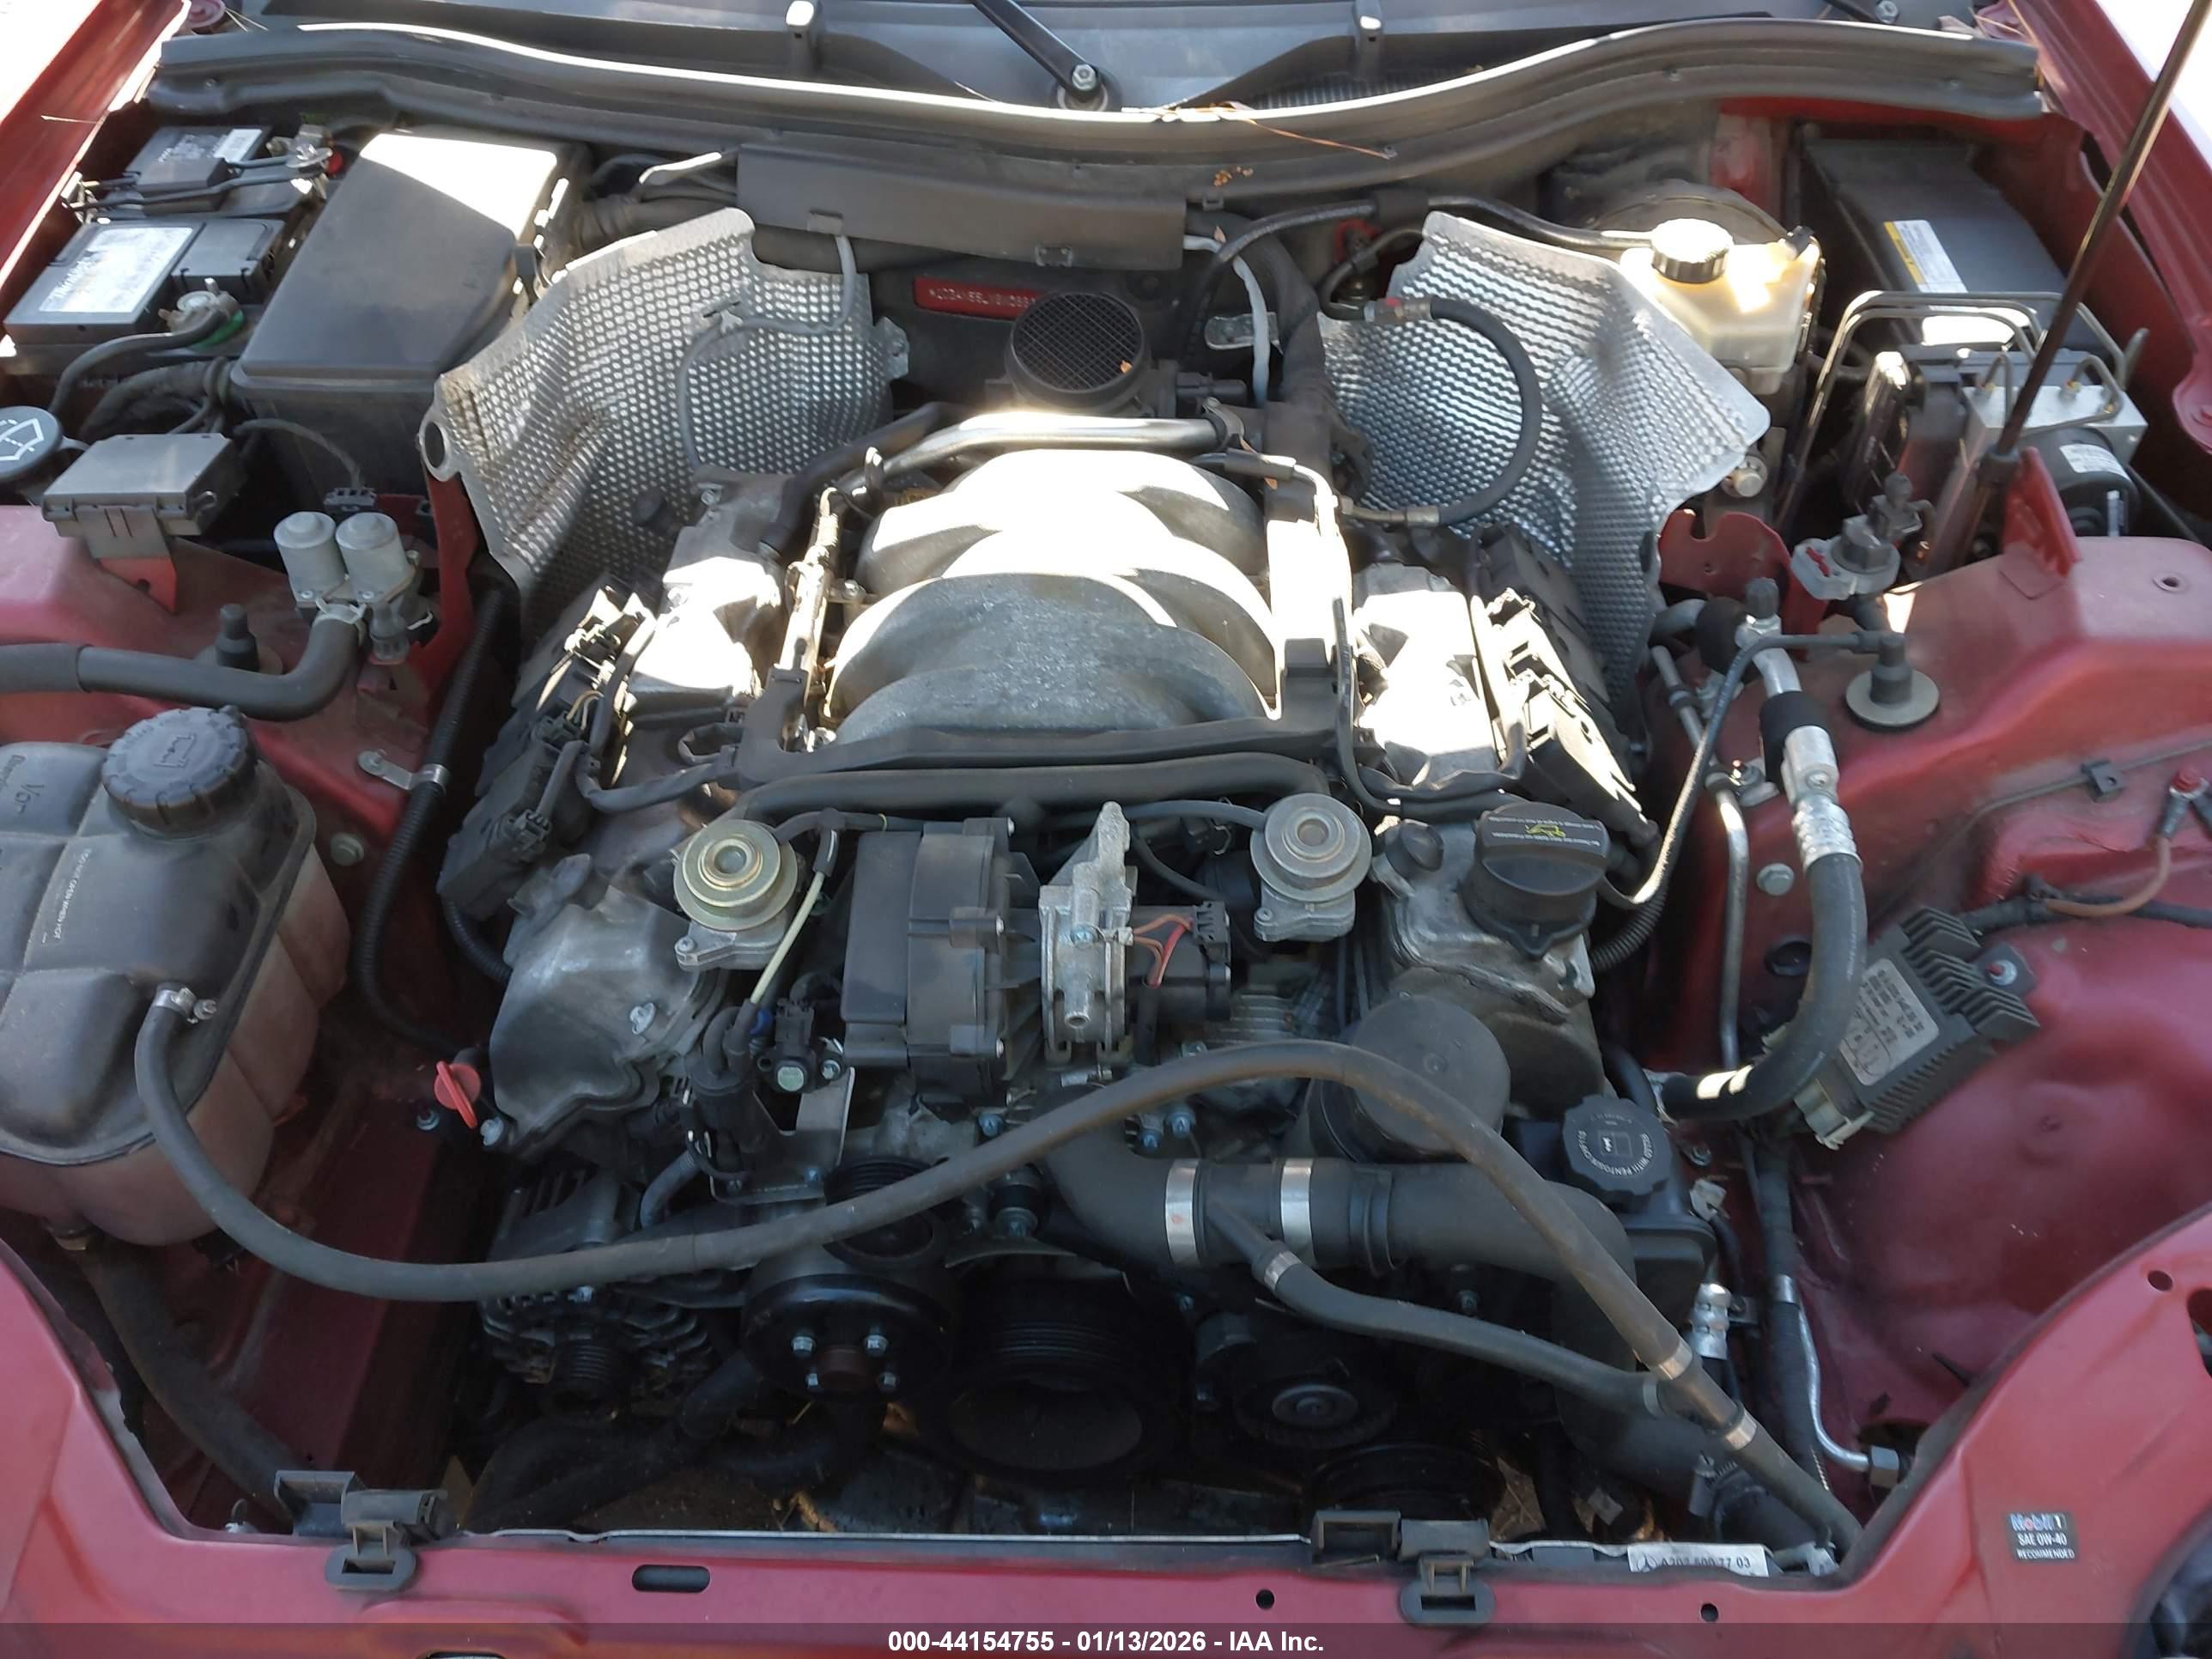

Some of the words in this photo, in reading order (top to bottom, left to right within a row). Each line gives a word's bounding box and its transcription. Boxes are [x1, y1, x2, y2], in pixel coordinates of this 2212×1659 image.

[2017, 1532, 2037, 1547] SAE
[2036, 1532, 2068, 1547] 0W-40
[2016, 1548, 2075, 1559] RECOMMENDED
[1736, 1556, 1751, 1569] 03
